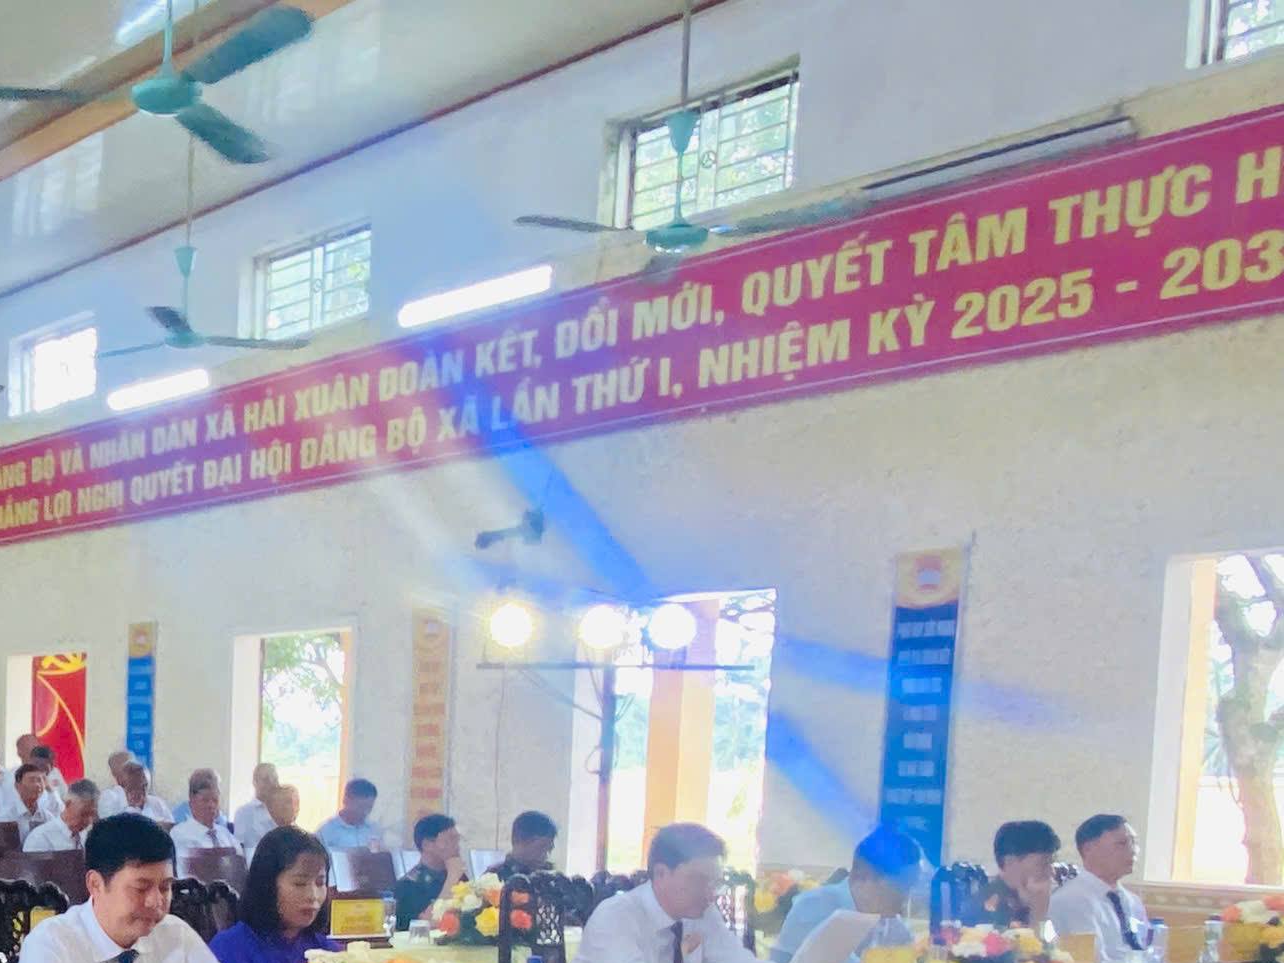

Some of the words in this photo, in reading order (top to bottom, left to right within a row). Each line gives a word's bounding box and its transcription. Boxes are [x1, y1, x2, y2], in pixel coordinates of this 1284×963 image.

[61, 442, 84, 476] VÀ
[89, 429, 145, 469] NHÂN
[151, 418, 197, 455] DÂN
[204, 404, 236, 444] XÃ
[243, 390, 285, 433] HẢI
[294, 373, 370, 422] XUÂN
[556, 296, 618, 359] ĐỔI
[632, 281, 725, 341] MỚI,
[741, 231, 892, 316] QUYẾT
[908, 208, 1028, 278] TÂM
[1049, 163, 1213, 245] THỰC
[77, 478, 124, 512] NGHỊ
[130, 456, 196, 505] QUYẾT
[250, 438, 292, 480] HỘI
[299, 423, 377, 470] ĐẢNG
[386, 406, 427, 456] BỘ
[437, 394, 480, 443] XÃ
[572, 356, 651, 414] THỨ
[659, 357, 684, 399] I,
[697, 318, 850, 389] NHIỆM
[868, 288, 936, 355] KỲ
[950, 269, 1093, 340] 2025
[1116, 281, 1138, 294] -
